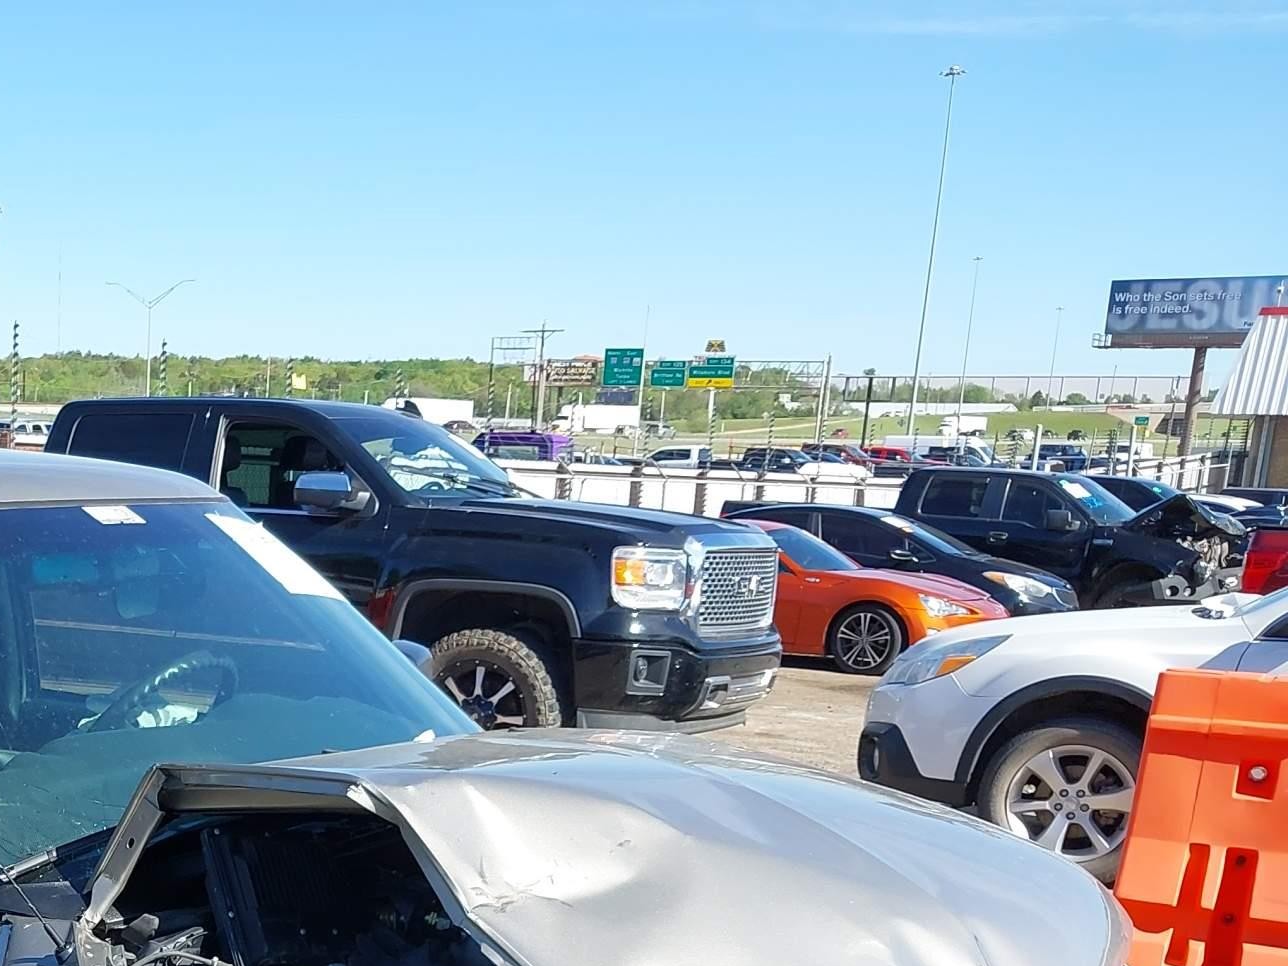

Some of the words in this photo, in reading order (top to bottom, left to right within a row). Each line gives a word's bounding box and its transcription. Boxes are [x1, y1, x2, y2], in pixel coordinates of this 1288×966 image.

[1114, 291, 1140, 302] Who
[1143, 291, 1162, 302] the
[1164, 291, 1187, 302] Son
[1190, 290, 1214, 301] sets
[1217, 289, 1242, 301] free
[1112, 305, 1122, 315] is
[1124, 305, 1148, 315] free
